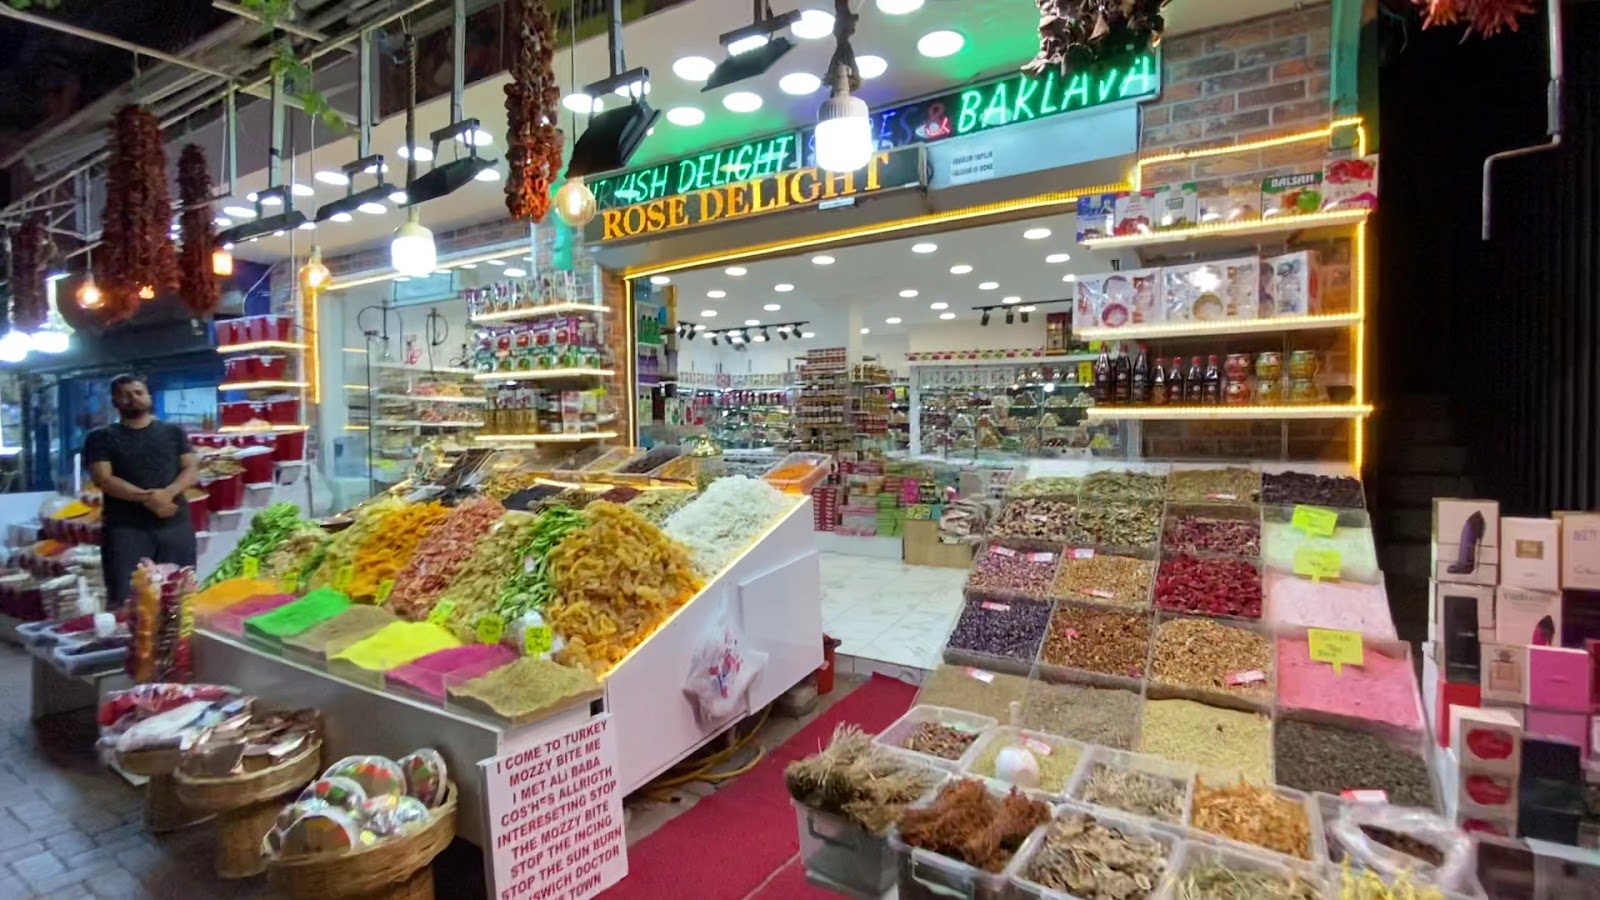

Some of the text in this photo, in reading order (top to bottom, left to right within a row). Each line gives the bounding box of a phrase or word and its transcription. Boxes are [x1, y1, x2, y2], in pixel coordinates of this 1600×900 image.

[957, 55, 1150, 134] BAKLAVA
[587, 165, 669, 209] URKISH
[678, 134, 795, 194] DELIGHT
[602, 152, 889, 240] ROSE DELIGHT
[496, 720, 607, 774] I COME TO TURKEY
[510, 739, 601, 787] MOZZY BITE ME
[513, 756, 600, 805] I MET ALI BABA
[558, 766, 612, 801] ALLRIGTH
[498, 780, 617, 848] INTERESETING STOP
[511, 800, 609, 860] THE MOZZY BITE
[502, 825, 622, 900] STOP THE SUN BURN
[510, 814, 612, 879] STOP THE INCING
[576, 845, 620, 877] DOCTOR
[570, 872, 601, 900] TOWN
